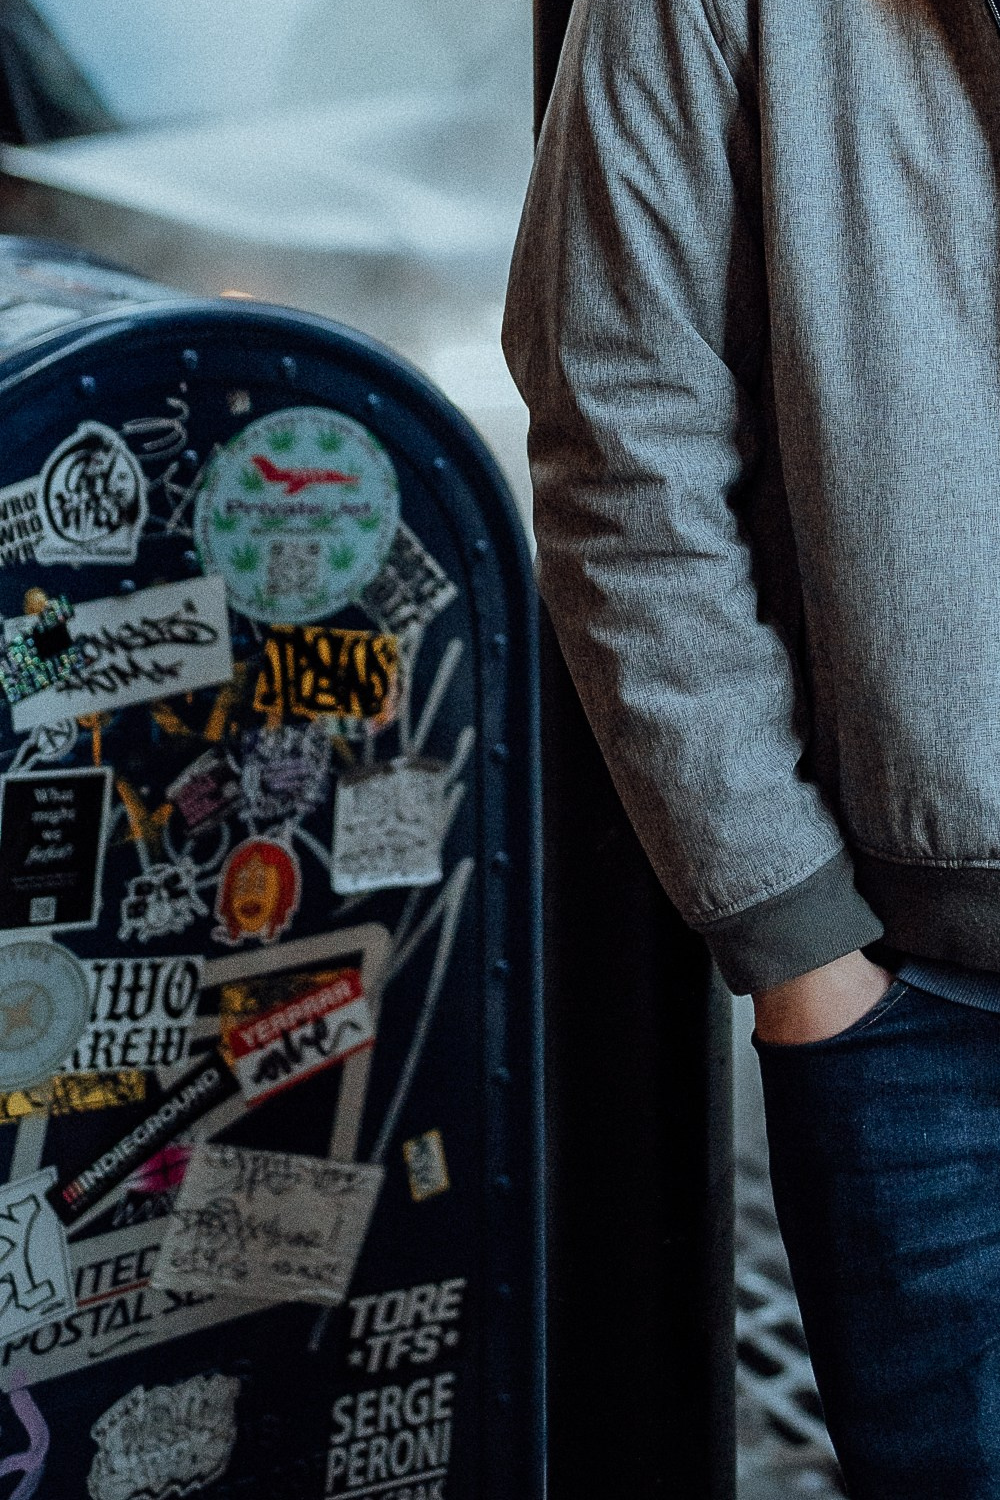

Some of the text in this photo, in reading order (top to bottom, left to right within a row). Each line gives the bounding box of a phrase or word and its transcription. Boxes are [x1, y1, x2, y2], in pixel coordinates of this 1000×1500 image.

[78, 1067, 221, 1192] INDIEGROUND
[330, 1372, 455, 1445] SERGE
[325, 1419, 452, 1493] PERONI
